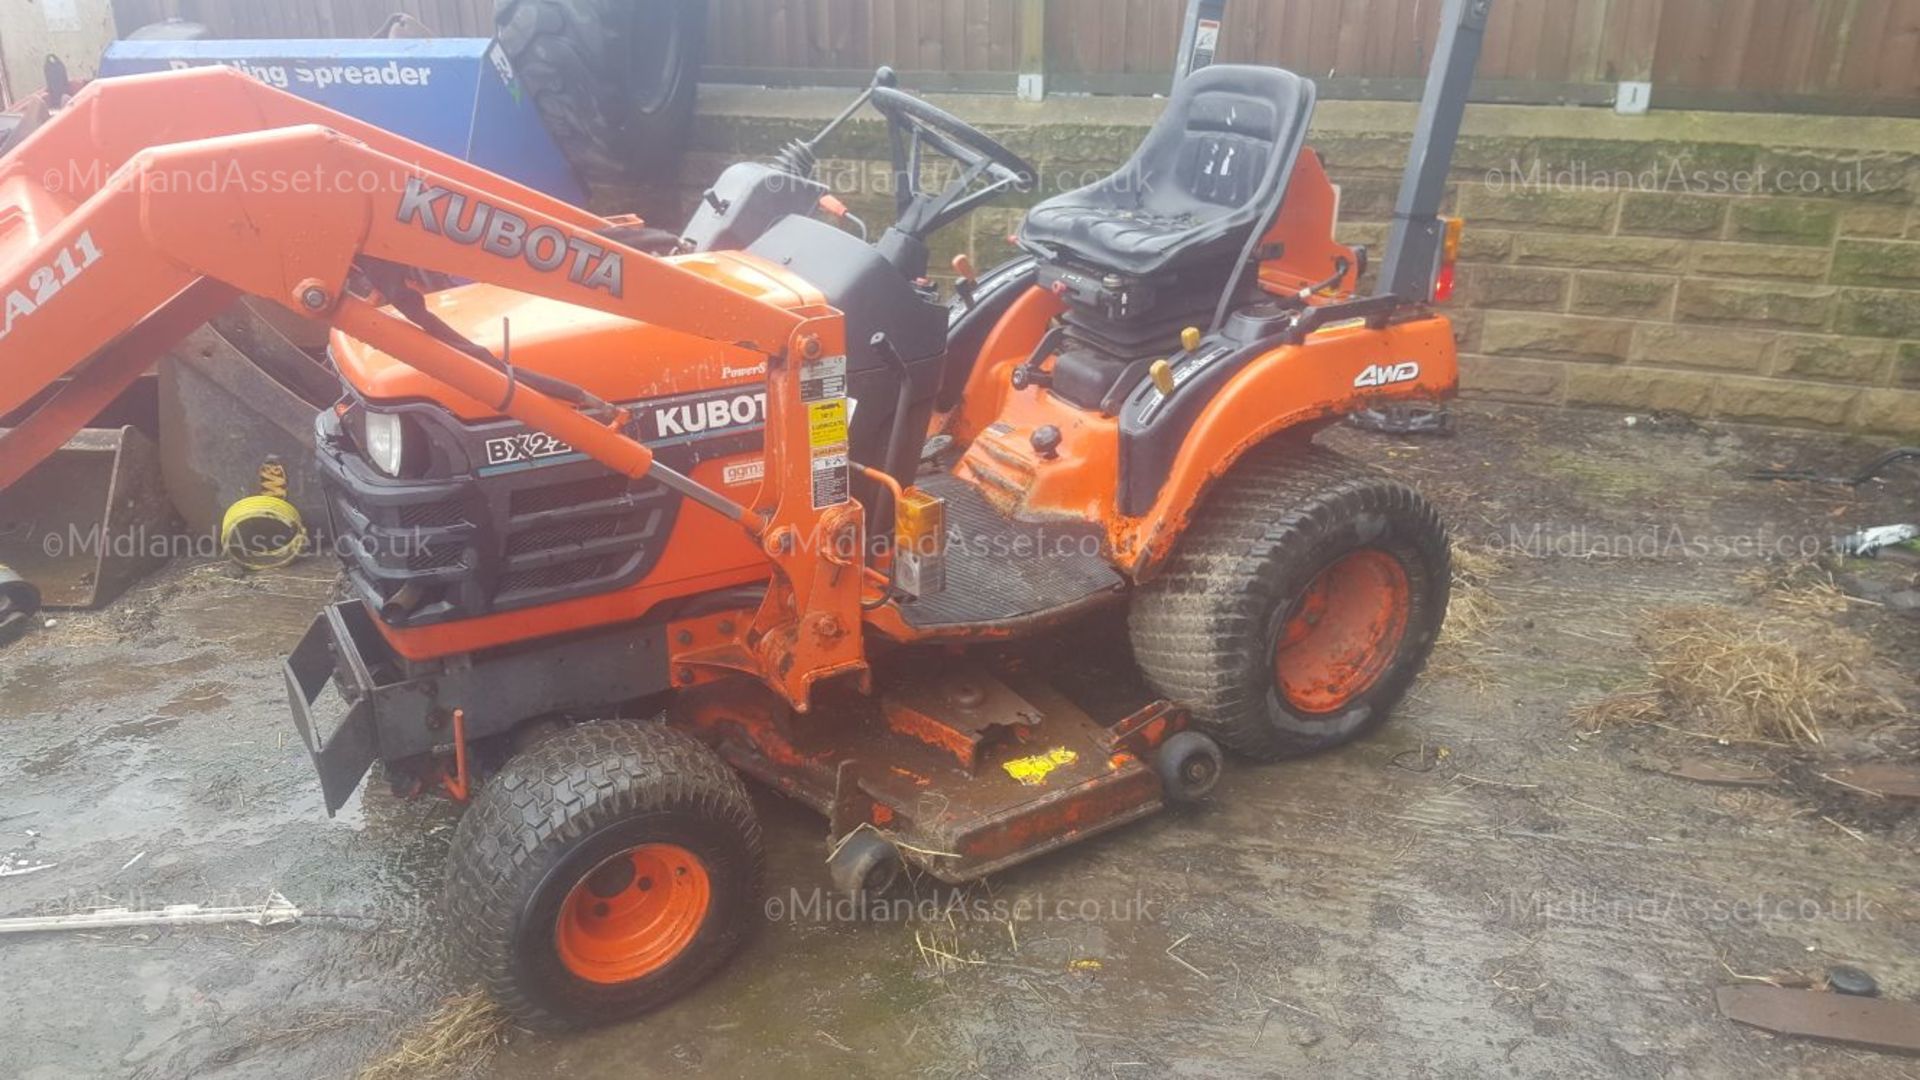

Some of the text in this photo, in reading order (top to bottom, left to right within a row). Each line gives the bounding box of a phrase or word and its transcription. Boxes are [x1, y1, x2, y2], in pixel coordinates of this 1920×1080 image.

[295, 60, 432, 88] Spreader
[396, 176, 624, 300] KUBOTA
[0, 229, 103, 338] A211
[1354, 362, 1419, 387] 4WD
